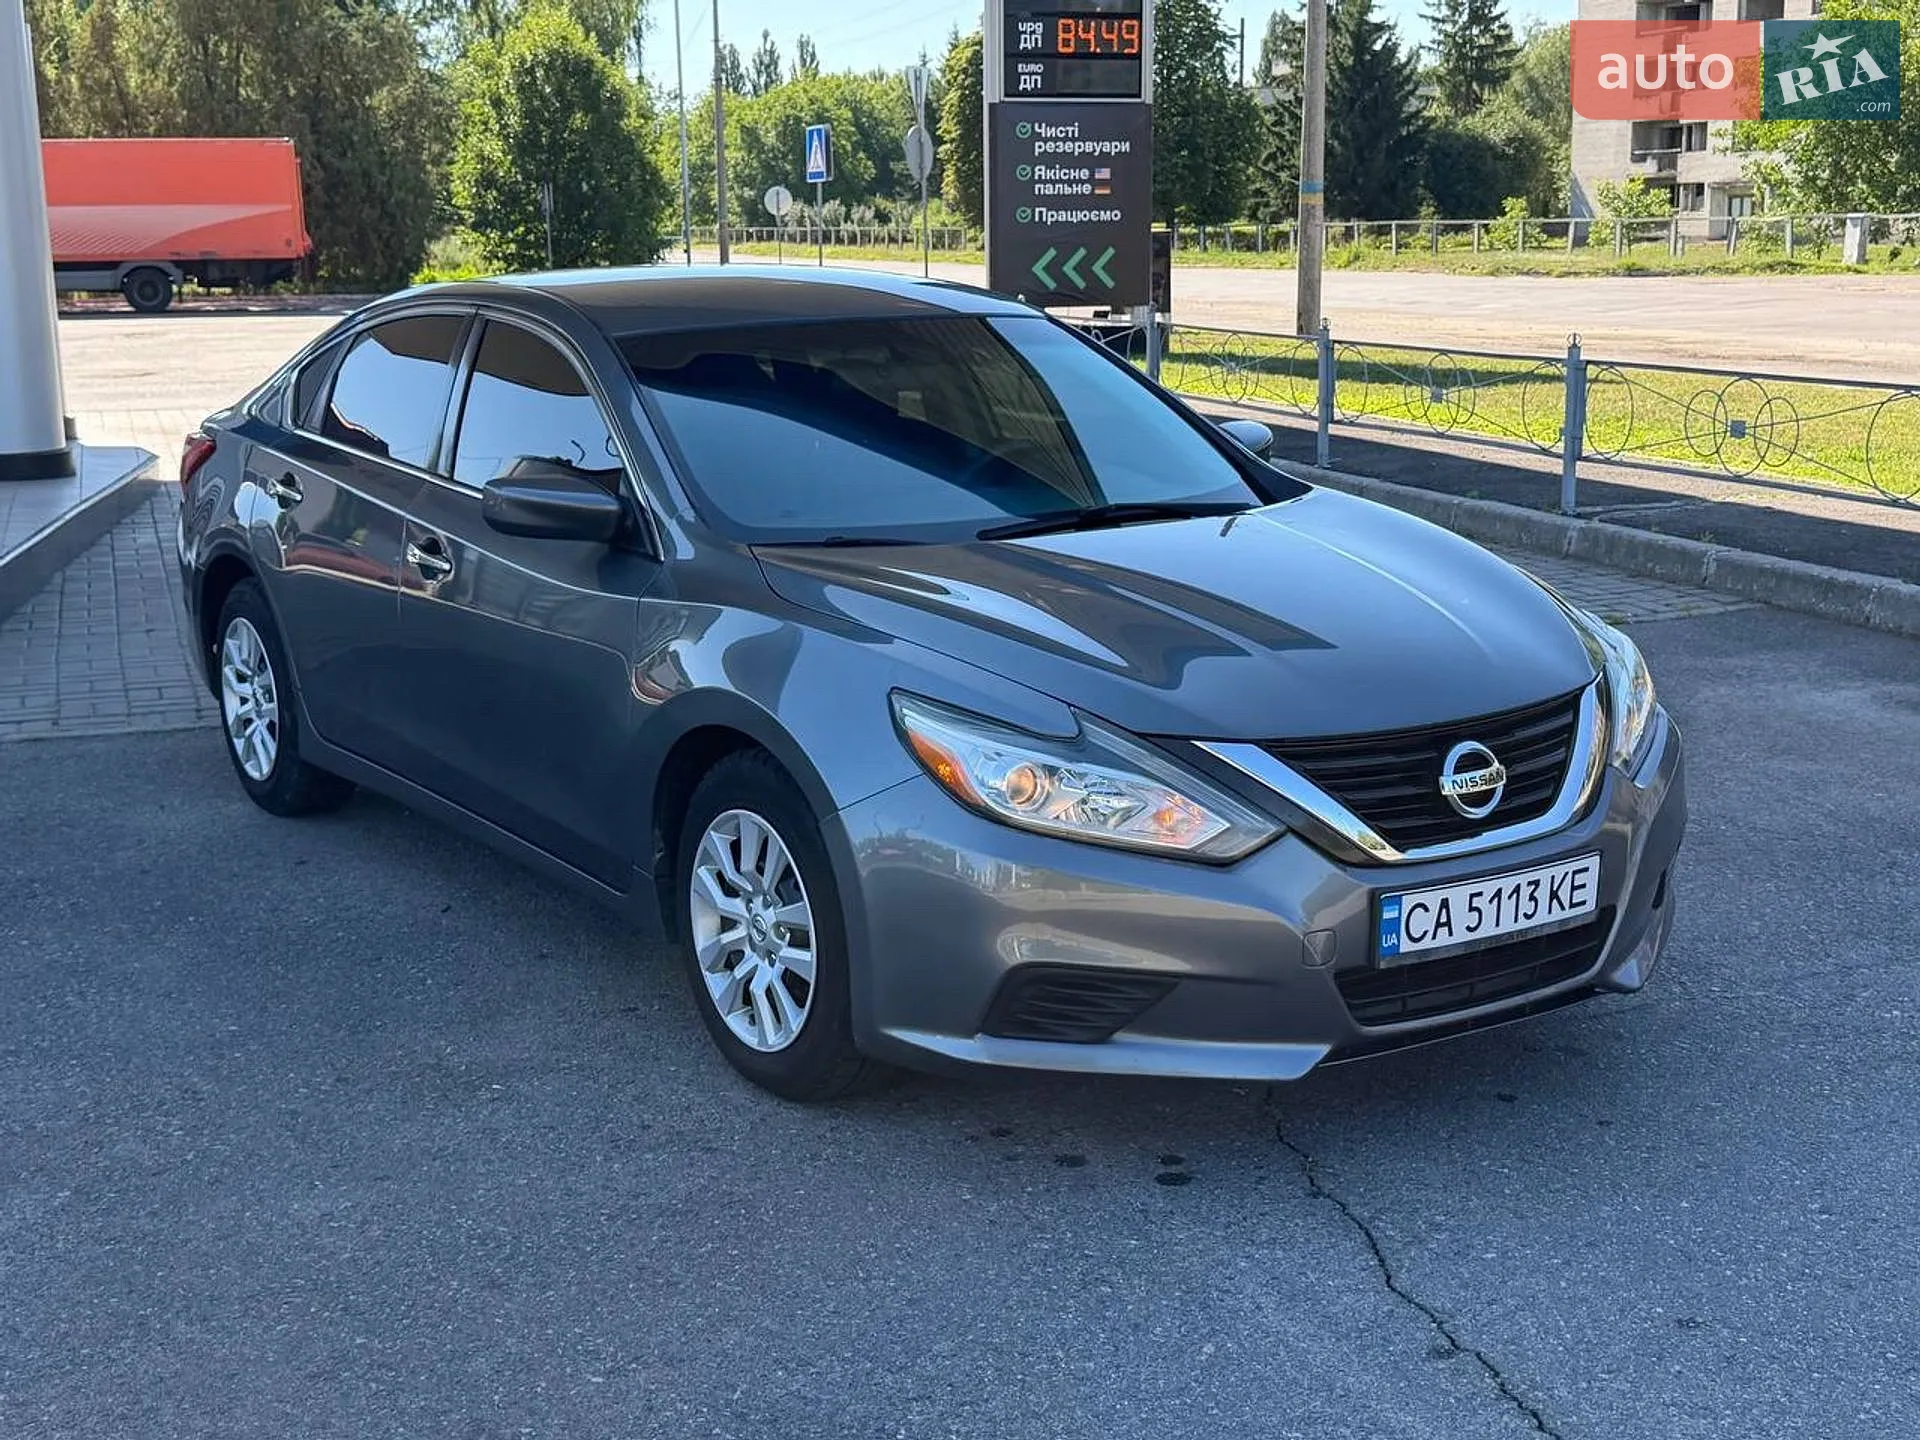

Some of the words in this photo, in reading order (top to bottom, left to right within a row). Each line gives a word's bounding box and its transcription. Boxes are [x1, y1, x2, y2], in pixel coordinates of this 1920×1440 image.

[1019, 34, 1042, 50] ДП
[1057, 18, 1140, 54] 84.49
[1017, 63, 1044, 73] EURO
[1019, 74, 1042, 91] ДП
[1034, 122, 1079, 138] Чисті
[1034, 141, 1131, 156] резервуари
[1034, 164, 1090, 180] Якісне
[1034, 183, 1093, 195] пальне
[1034, 207, 1122, 226] Працюємо
[1452, 769, 1504, 791] NISSAN
[1404, 897, 1454, 944] CA
[1464, 878, 1541, 934] 5113
[1547, 866, 1590, 915] KE
[1382, 932, 1399, 948] UA
